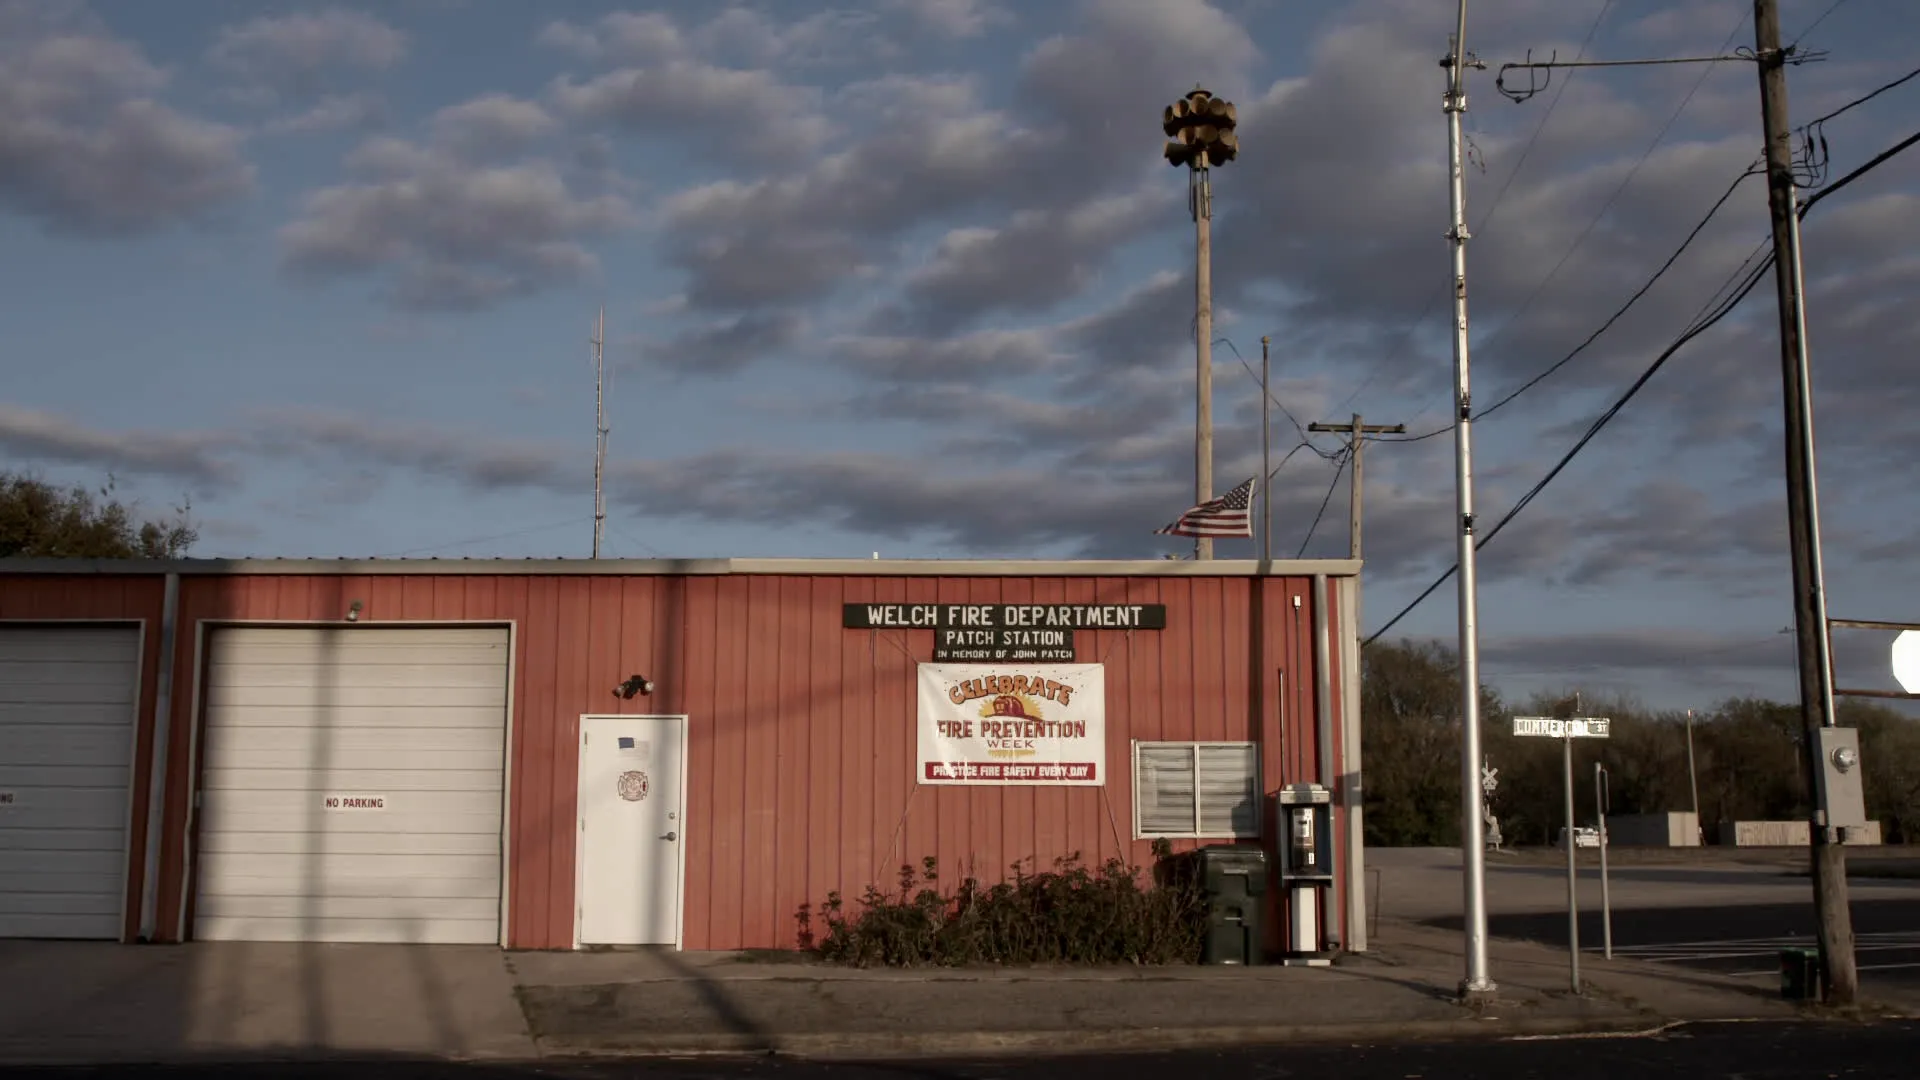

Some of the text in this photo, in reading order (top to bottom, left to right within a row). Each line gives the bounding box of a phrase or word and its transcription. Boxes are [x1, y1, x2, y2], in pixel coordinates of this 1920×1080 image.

[867, 605, 1143, 626] WELCH FIRE DEPARTMENT
[946, 630, 1064, 646] PATCH STATION
[937, 649, 1073, 659] IN MEMORY OF JOHN PATCH
[948, 674, 1074, 707] CELEBRATE
[936, 719, 1086, 739] FIRE PREVENTION
[1516, 719, 1607, 736] COMMERCL ST
[987, 739, 1035, 749] WEEK
[933, 765, 1089, 778] PRACTICE FIRE SAFETY EVERY DAY
[326, 798, 383, 808] NO PARKING
